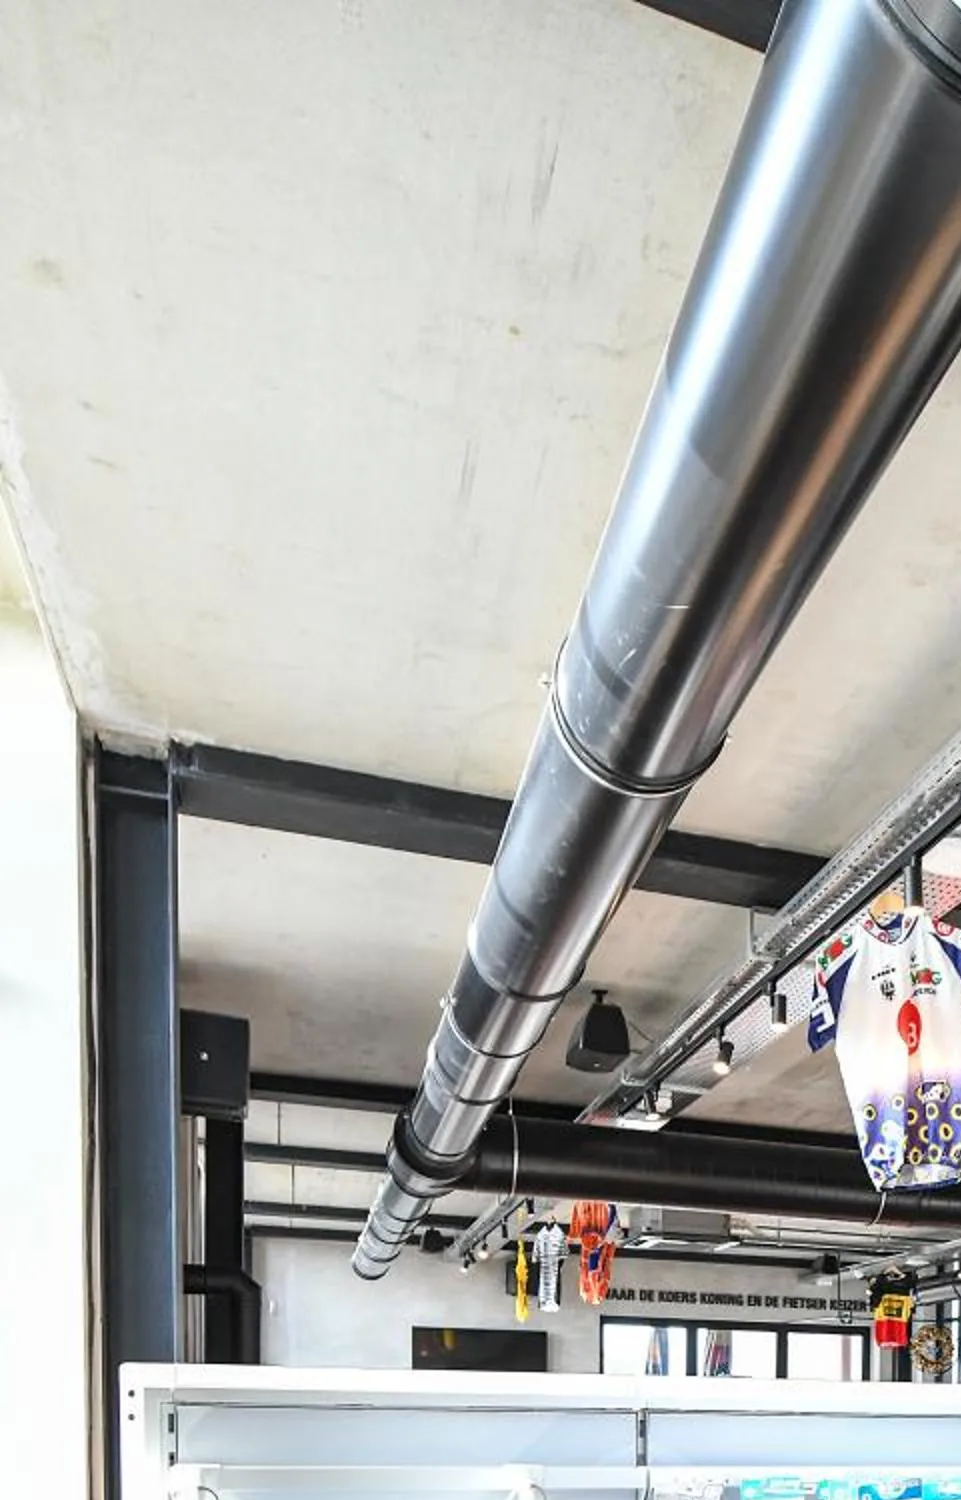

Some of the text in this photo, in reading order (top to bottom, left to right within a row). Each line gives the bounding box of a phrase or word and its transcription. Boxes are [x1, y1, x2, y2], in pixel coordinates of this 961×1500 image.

[639, 1289, 655, 1303] DE
[658, 1290, 697, 1304] KOERS
[700, 1292, 743, 1306] KONING
[747, 1294, 762, 1307] EN
[765, 1296, 779, 1309] DE
[782, 1297, 827, 1311] FIETSER
[830, 1299, 867, 1312] KEIZER
